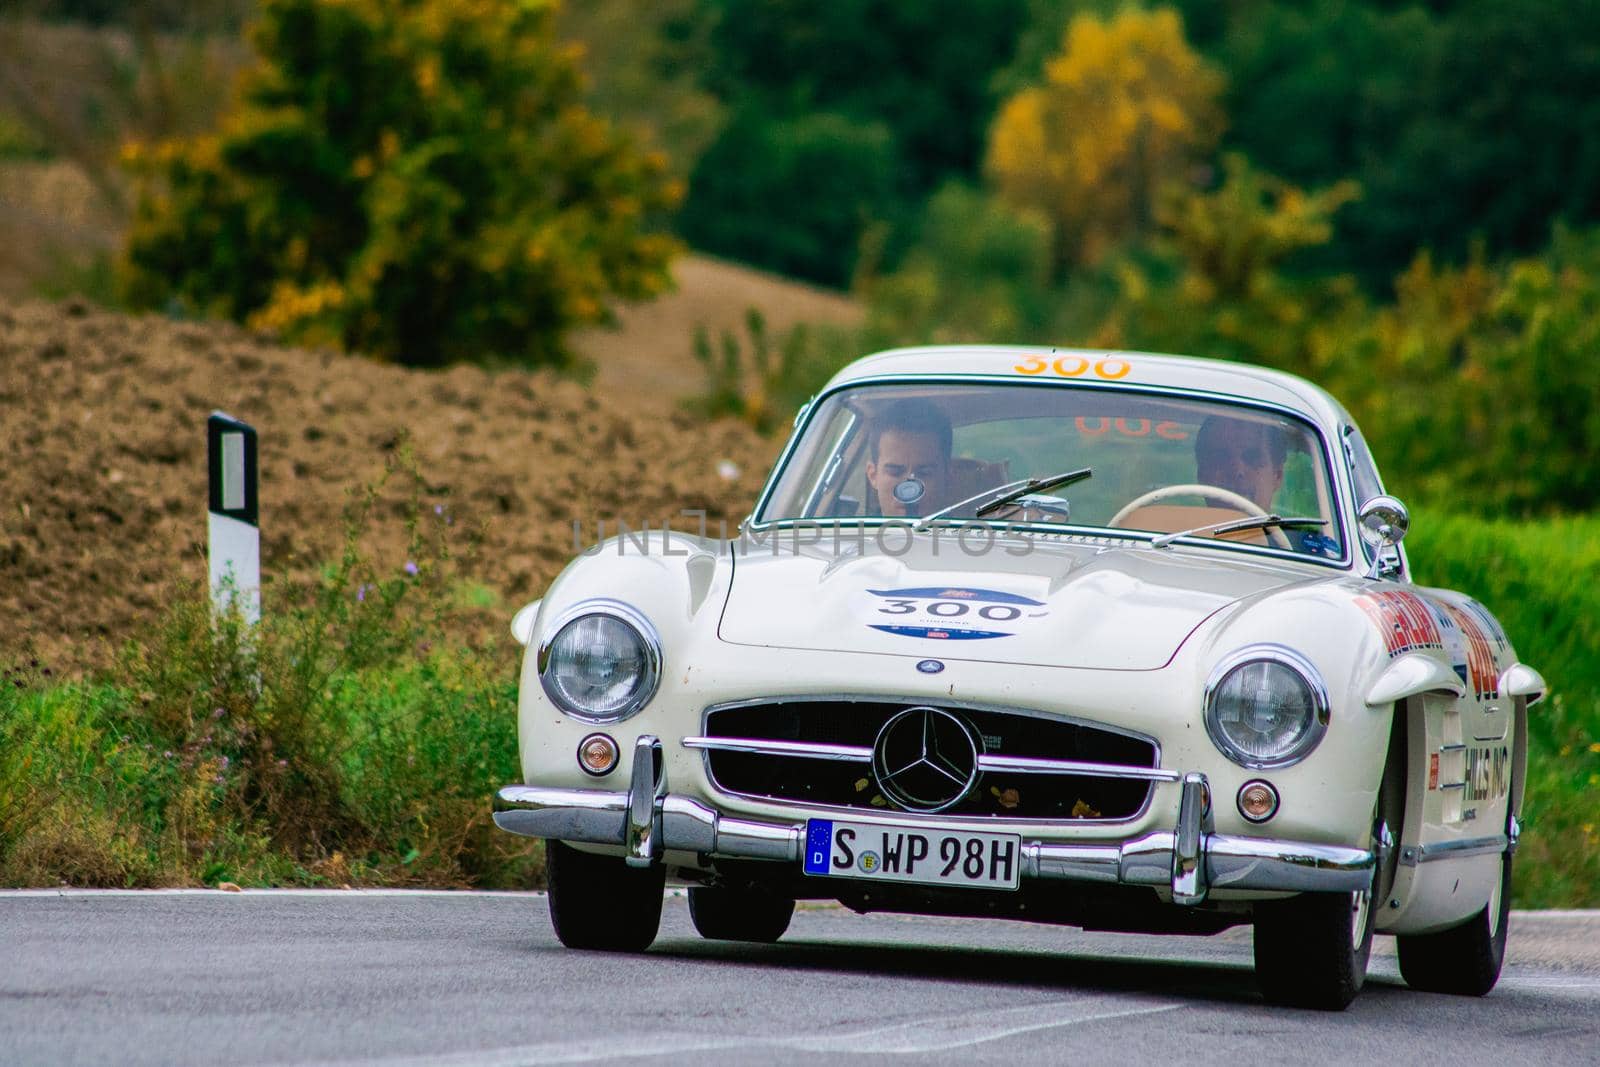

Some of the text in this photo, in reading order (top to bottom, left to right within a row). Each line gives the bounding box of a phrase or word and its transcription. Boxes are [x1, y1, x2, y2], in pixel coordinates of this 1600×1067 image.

[1013, 353, 1131, 379] 300
[878, 599, 1021, 621] 300
[813, 852, 823, 865] D
[832, 828, 1014, 881] S WP 98H
